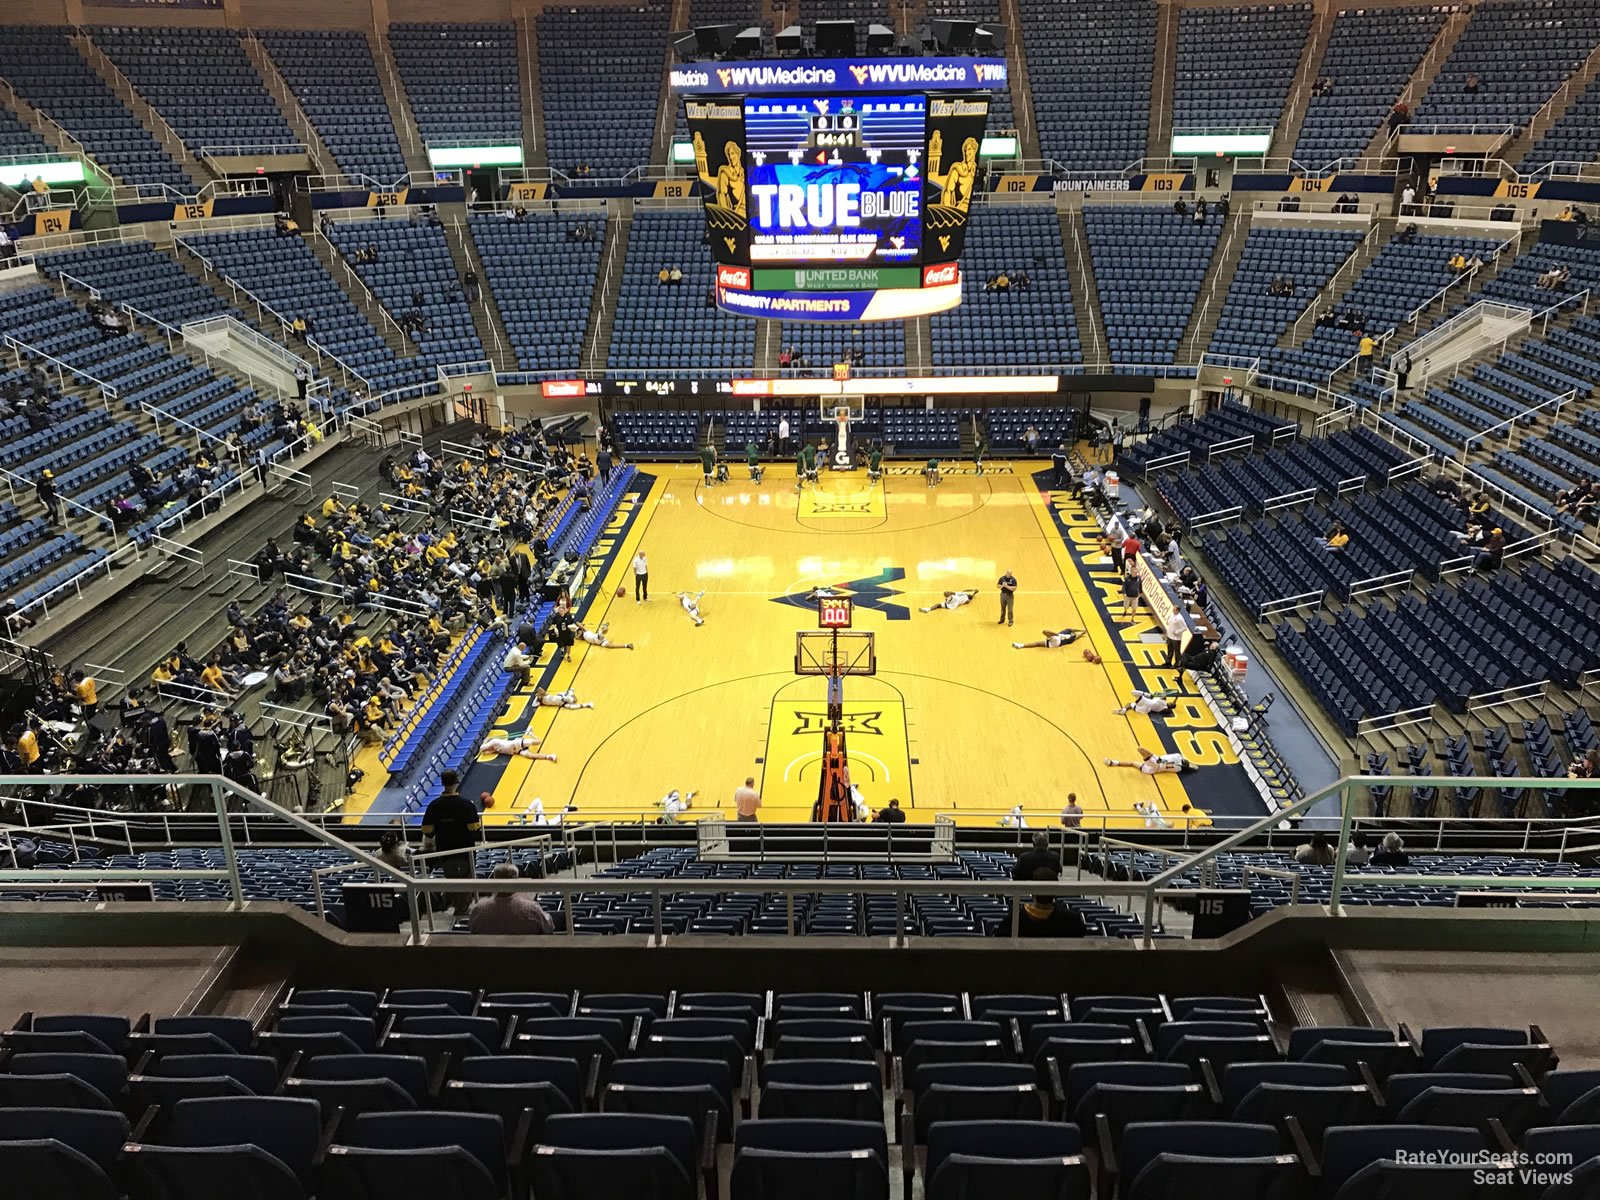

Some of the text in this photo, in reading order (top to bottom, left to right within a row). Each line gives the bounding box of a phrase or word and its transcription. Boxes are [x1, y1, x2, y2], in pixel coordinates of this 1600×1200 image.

[818, 116, 827, 129] 0
[843, 116, 852, 129] 0
[816, 133, 853, 145] 54:41
[1007, 181, 1026, 192] 102
[1053, 180, 1130, 191] MOUNTAINEERS
[1154, 179, 1173, 190] 103
[1301, 180, 1322, 191] 104
[518, 188, 536, 200] 127
[664, 186, 682, 197] 128
[1507, 185, 1528, 198] 105
[377, 193, 398, 205] 126
[861, 191, 919, 217] BLUE
[184, 205, 205, 218] 125
[752, 184, 860, 228] TRUE
[42, 218, 62, 232] 124
[806, 269, 879, 281] UNITED BANK
[770, 298, 850, 312] APARTMENTS
[835, 451, 850, 465] G
[825, 608, 845, 622] 00
[368, 893, 394, 908] 115
[1200, 899, 1224, 915] 115
